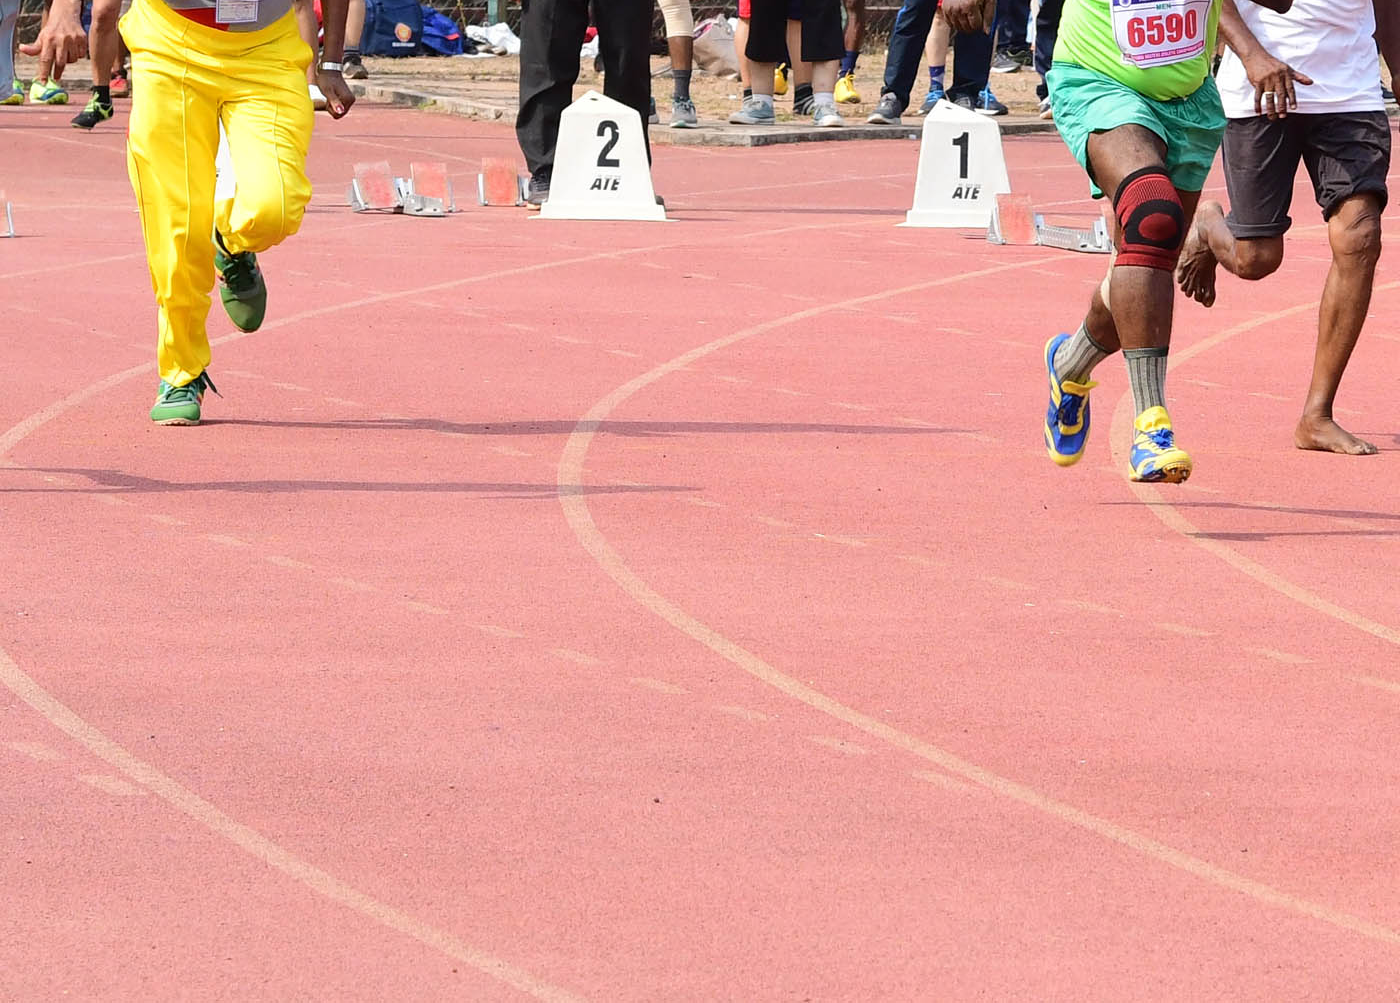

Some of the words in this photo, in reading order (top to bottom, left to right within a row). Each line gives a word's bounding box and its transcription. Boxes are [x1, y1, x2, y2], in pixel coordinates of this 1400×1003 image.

[1127, 9, 1197, 48] 6590
[596, 120, 620, 167] 2
[952, 131, 969, 179] 1
[589, 176, 621, 191] ATE
[952, 185, 981, 200] ATE
